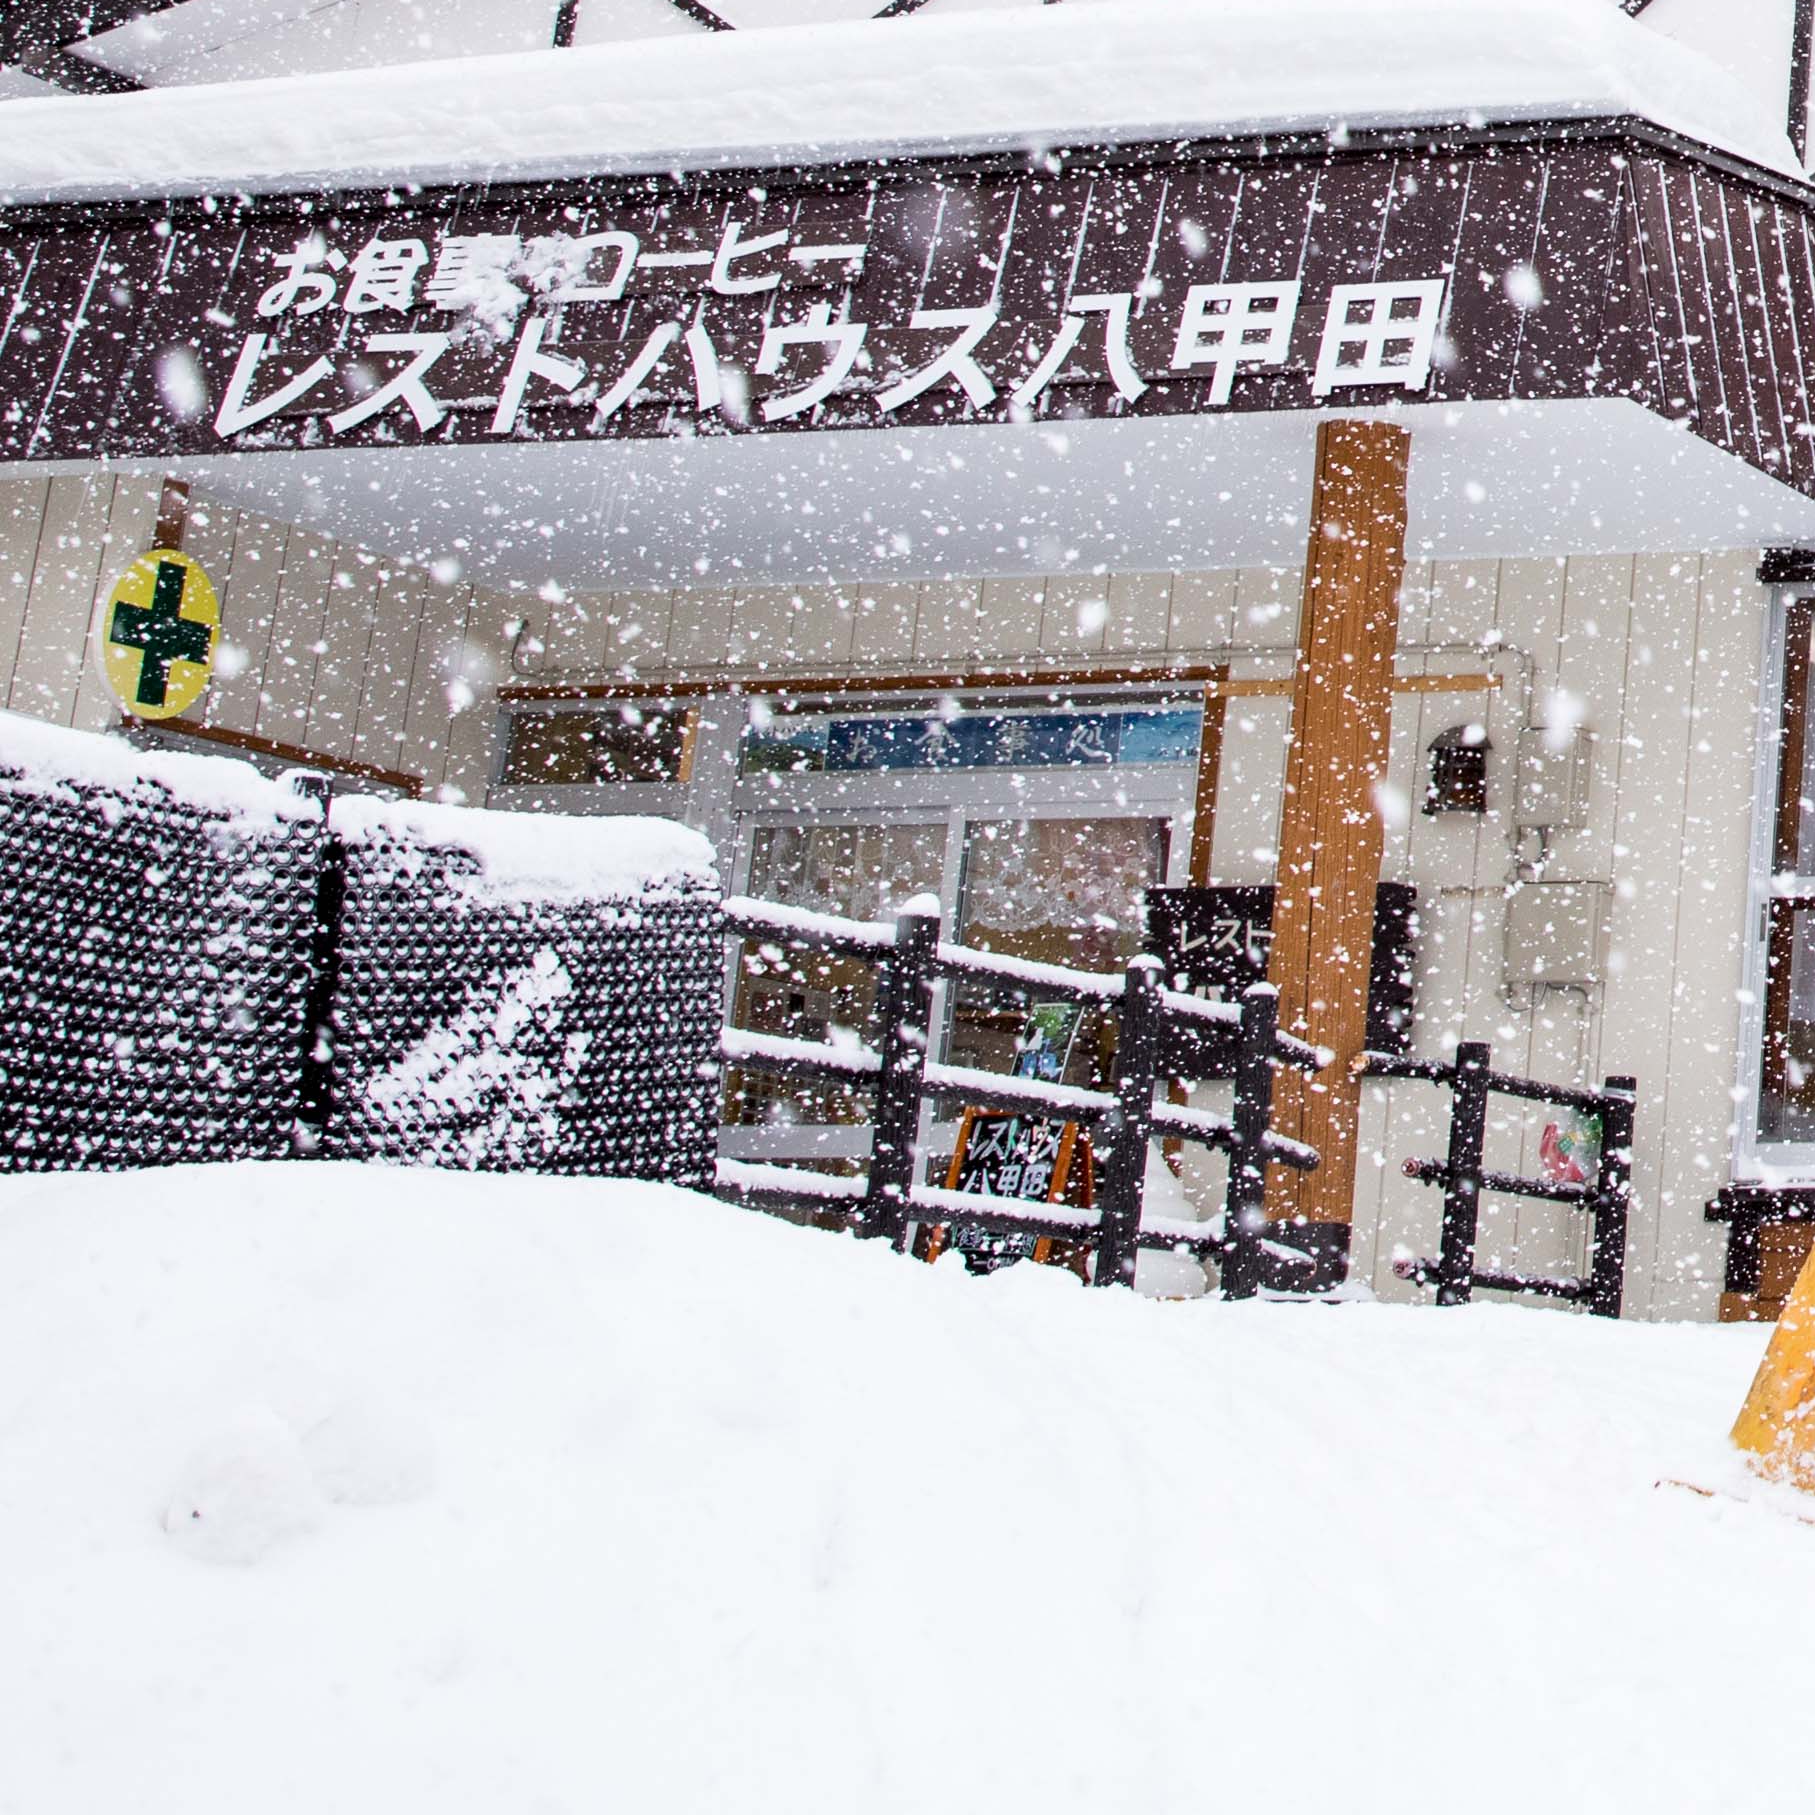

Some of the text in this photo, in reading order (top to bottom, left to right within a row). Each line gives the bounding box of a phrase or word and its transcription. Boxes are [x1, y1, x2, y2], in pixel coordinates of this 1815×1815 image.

[213, 277, 1446, 439] レストハウス八甲田
[846, 721, 1113, 763] お食事処
